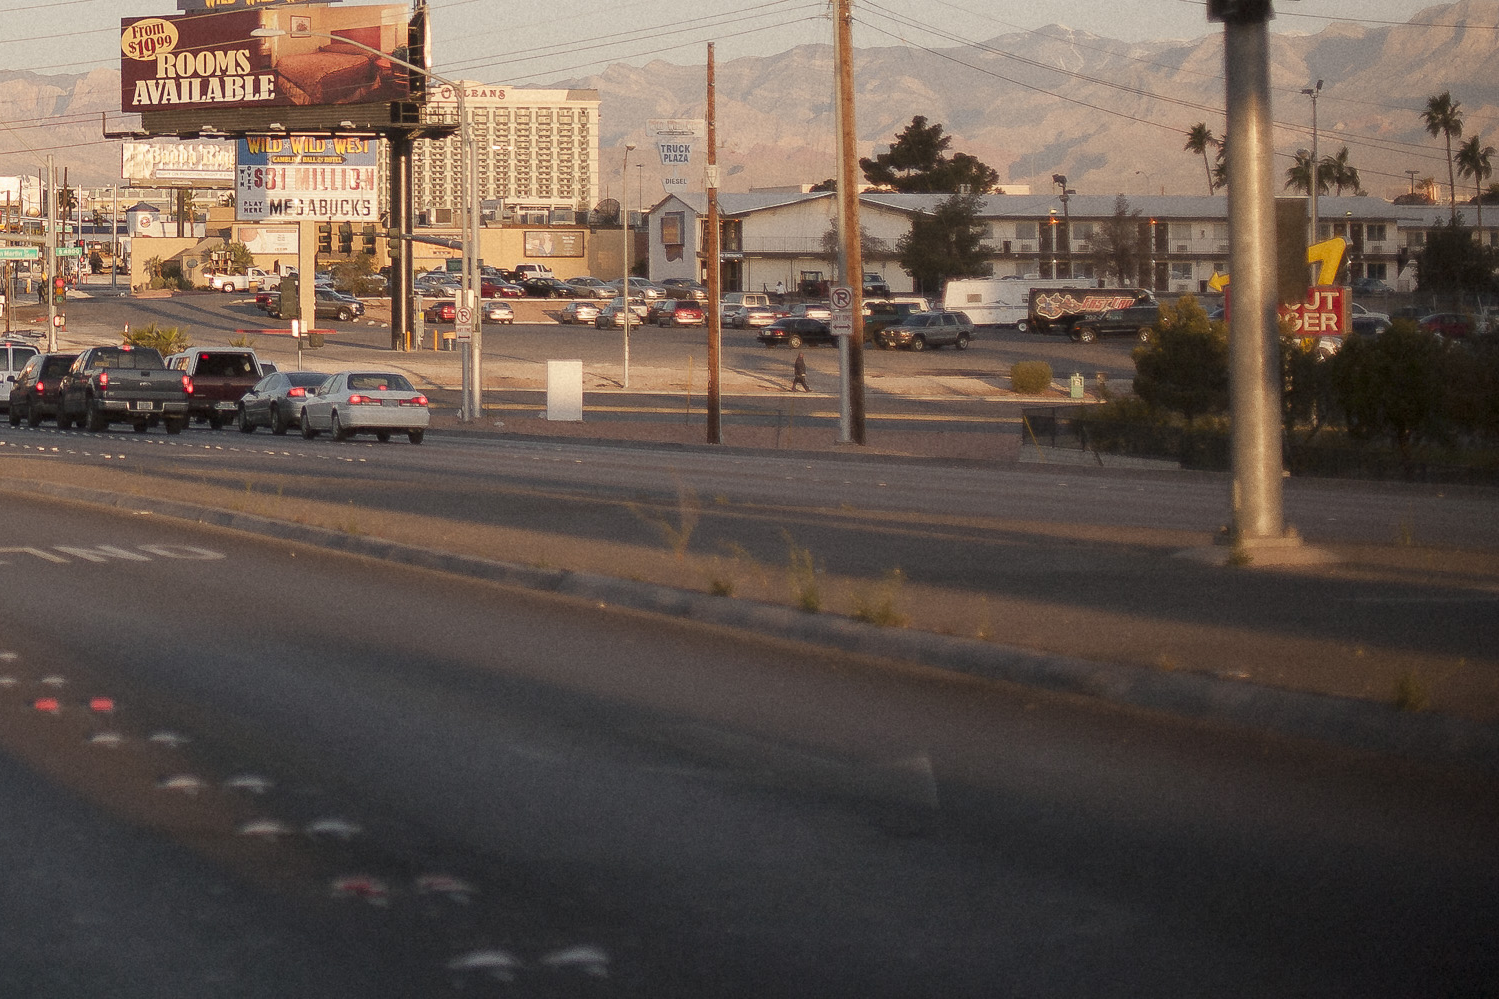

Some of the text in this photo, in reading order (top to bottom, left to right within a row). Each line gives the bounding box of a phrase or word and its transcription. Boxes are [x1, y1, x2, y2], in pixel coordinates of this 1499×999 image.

[132, 23, 165, 39] From
[156, 49, 251, 78] ROOMS
[132, 75, 275, 105] AVAILABLE
[441, 87, 506, 99] OLEANS
[246, 137, 370, 155] WILD WILD WEST
[661, 145, 690, 153] TRUCK
[664, 154, 689, 162] PLAZA
[254, 168, 374, 190] $31 MILLION
[270, 199, 371, 216] MEGABUCKS
[1277, 312, 1339, 331] GER
